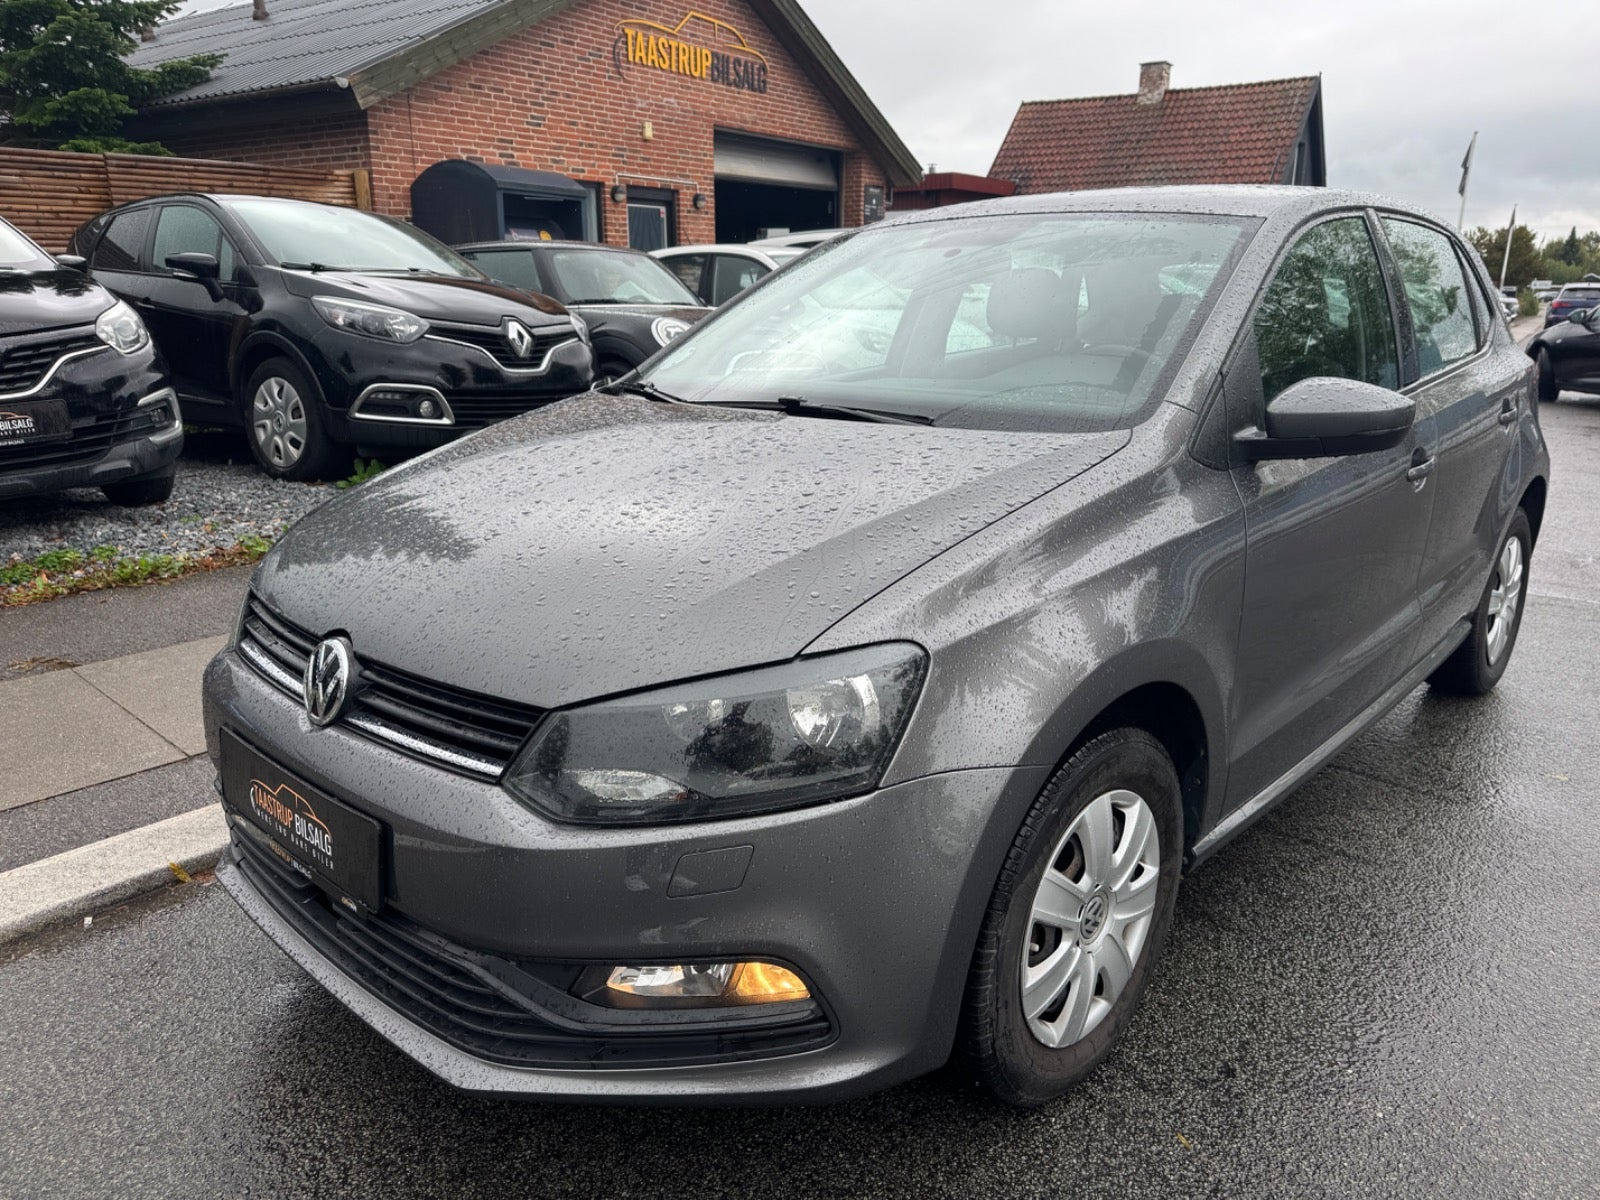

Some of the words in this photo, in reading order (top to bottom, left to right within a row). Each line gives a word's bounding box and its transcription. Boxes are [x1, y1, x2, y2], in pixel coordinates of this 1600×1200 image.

[624, 28, 712, 79] TAASTRUP
[711, 52, 767, 93] BILSALG
[253, 784, 293, 829] TAASTRUP
[294, 813, 332, 856] BILSALG
